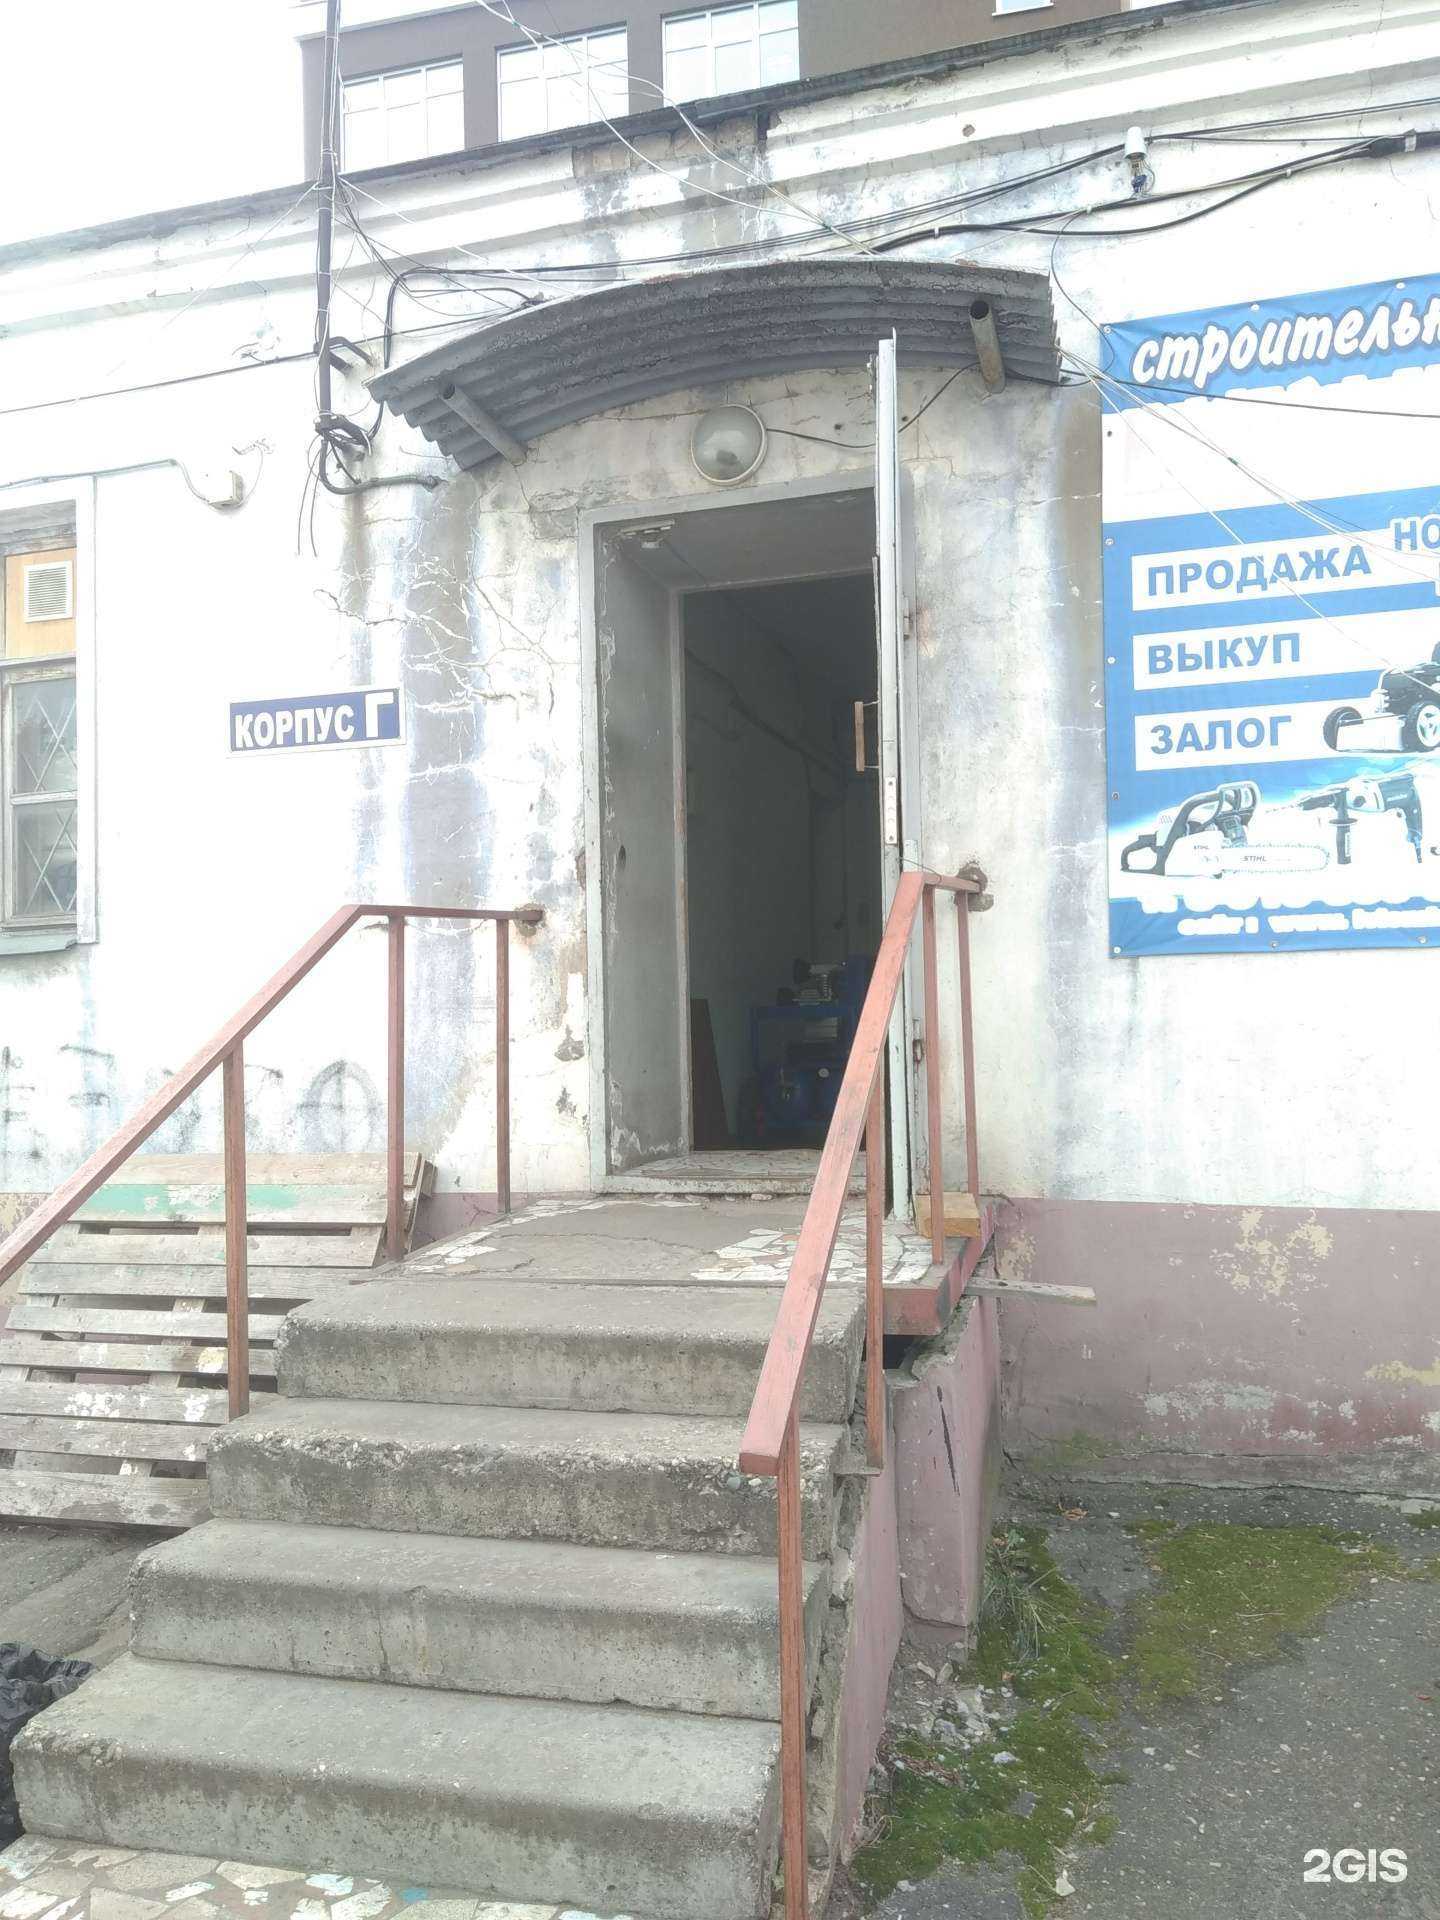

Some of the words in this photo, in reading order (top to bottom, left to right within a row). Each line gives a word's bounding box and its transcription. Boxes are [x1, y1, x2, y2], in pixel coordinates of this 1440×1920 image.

[1148, 546, 1371, 596] ПРОДАЖА
[1148, 633, 1300, 675] ВЫКУП
[235, 705, 355, 748] КОРПУС
[365, 692, 394, 738] Г
[1150, 716, 1291, 754] ЗАЛОГ
